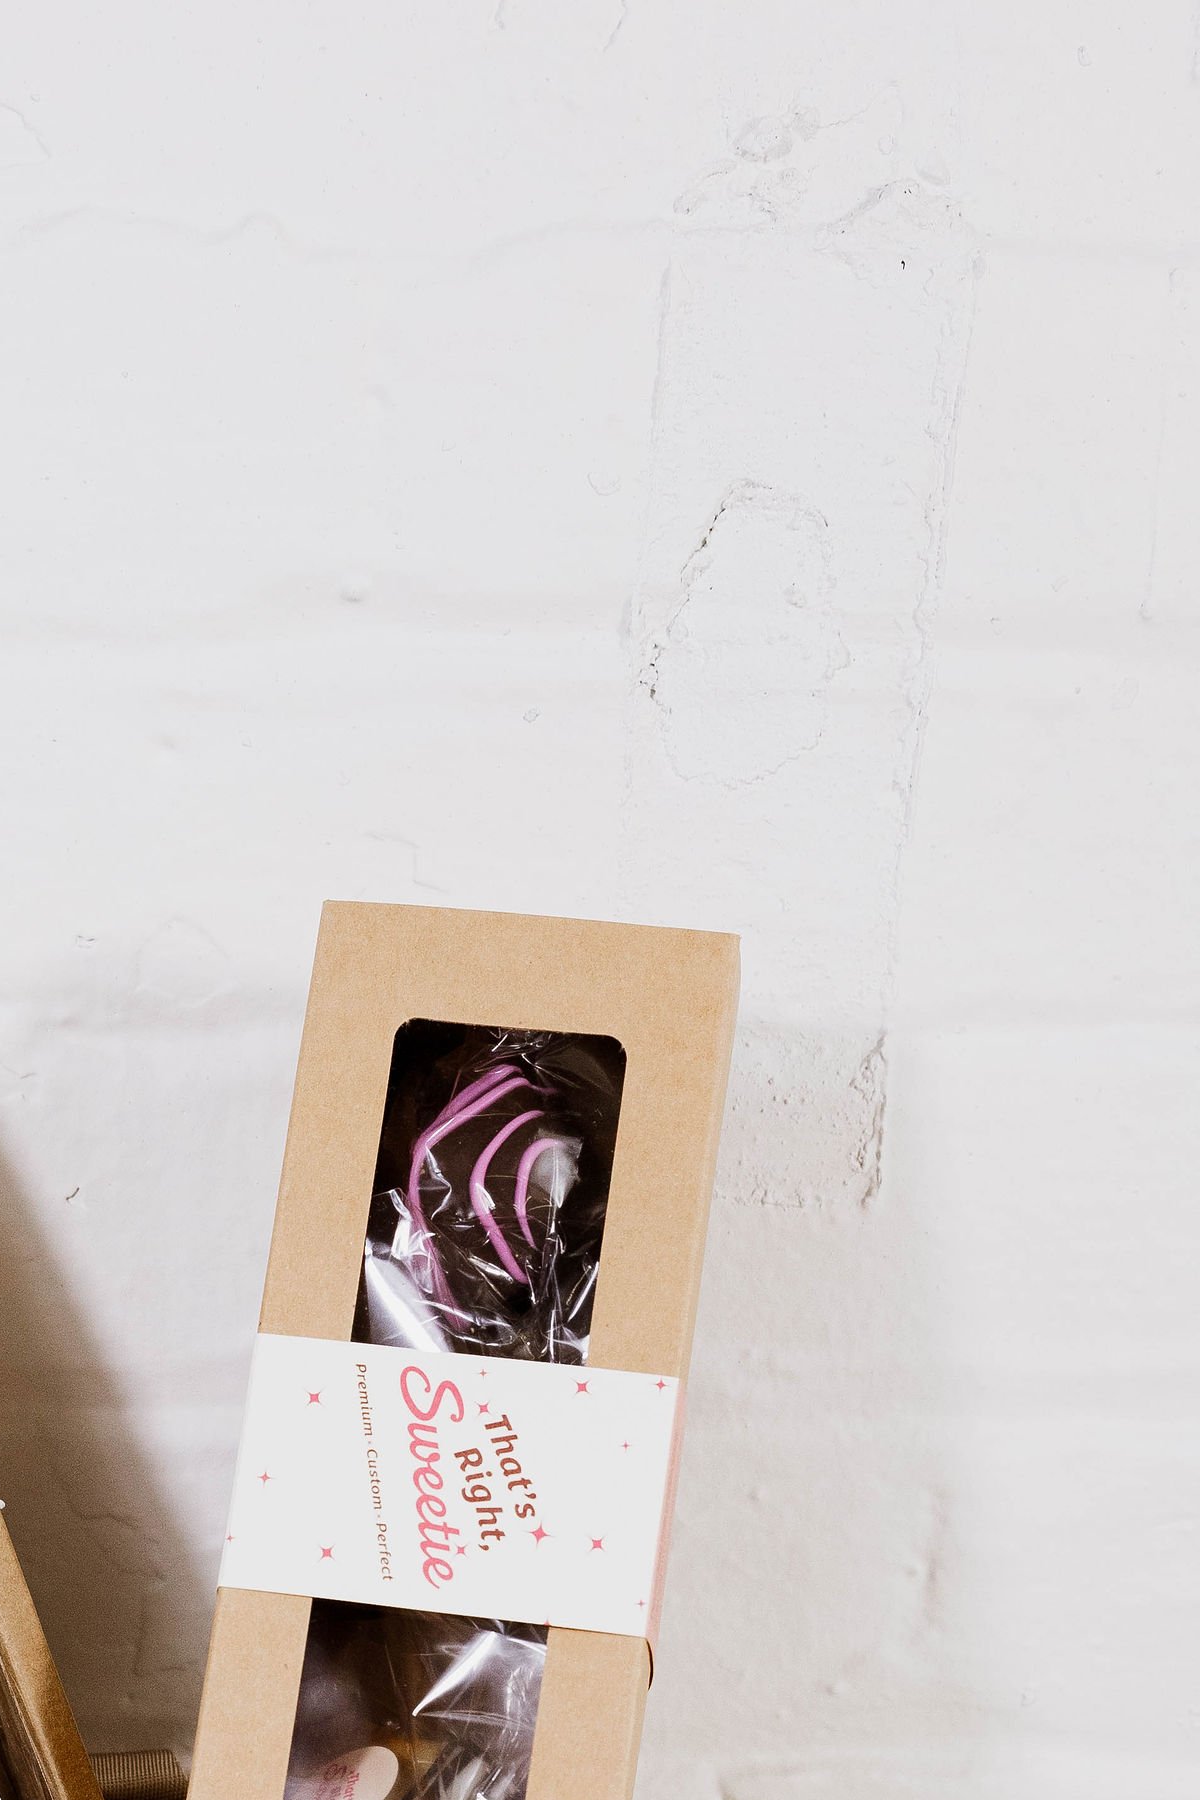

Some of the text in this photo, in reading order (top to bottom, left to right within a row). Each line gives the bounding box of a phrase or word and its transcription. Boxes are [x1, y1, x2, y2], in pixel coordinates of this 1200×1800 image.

[356, 1363, 393, 1581] Premium Custom Perfect
[400, 1365, 464, 1589] Sweetie
[453, 1447, 506, 1551] Right,
[484, 1414, 537, 1519] That's
